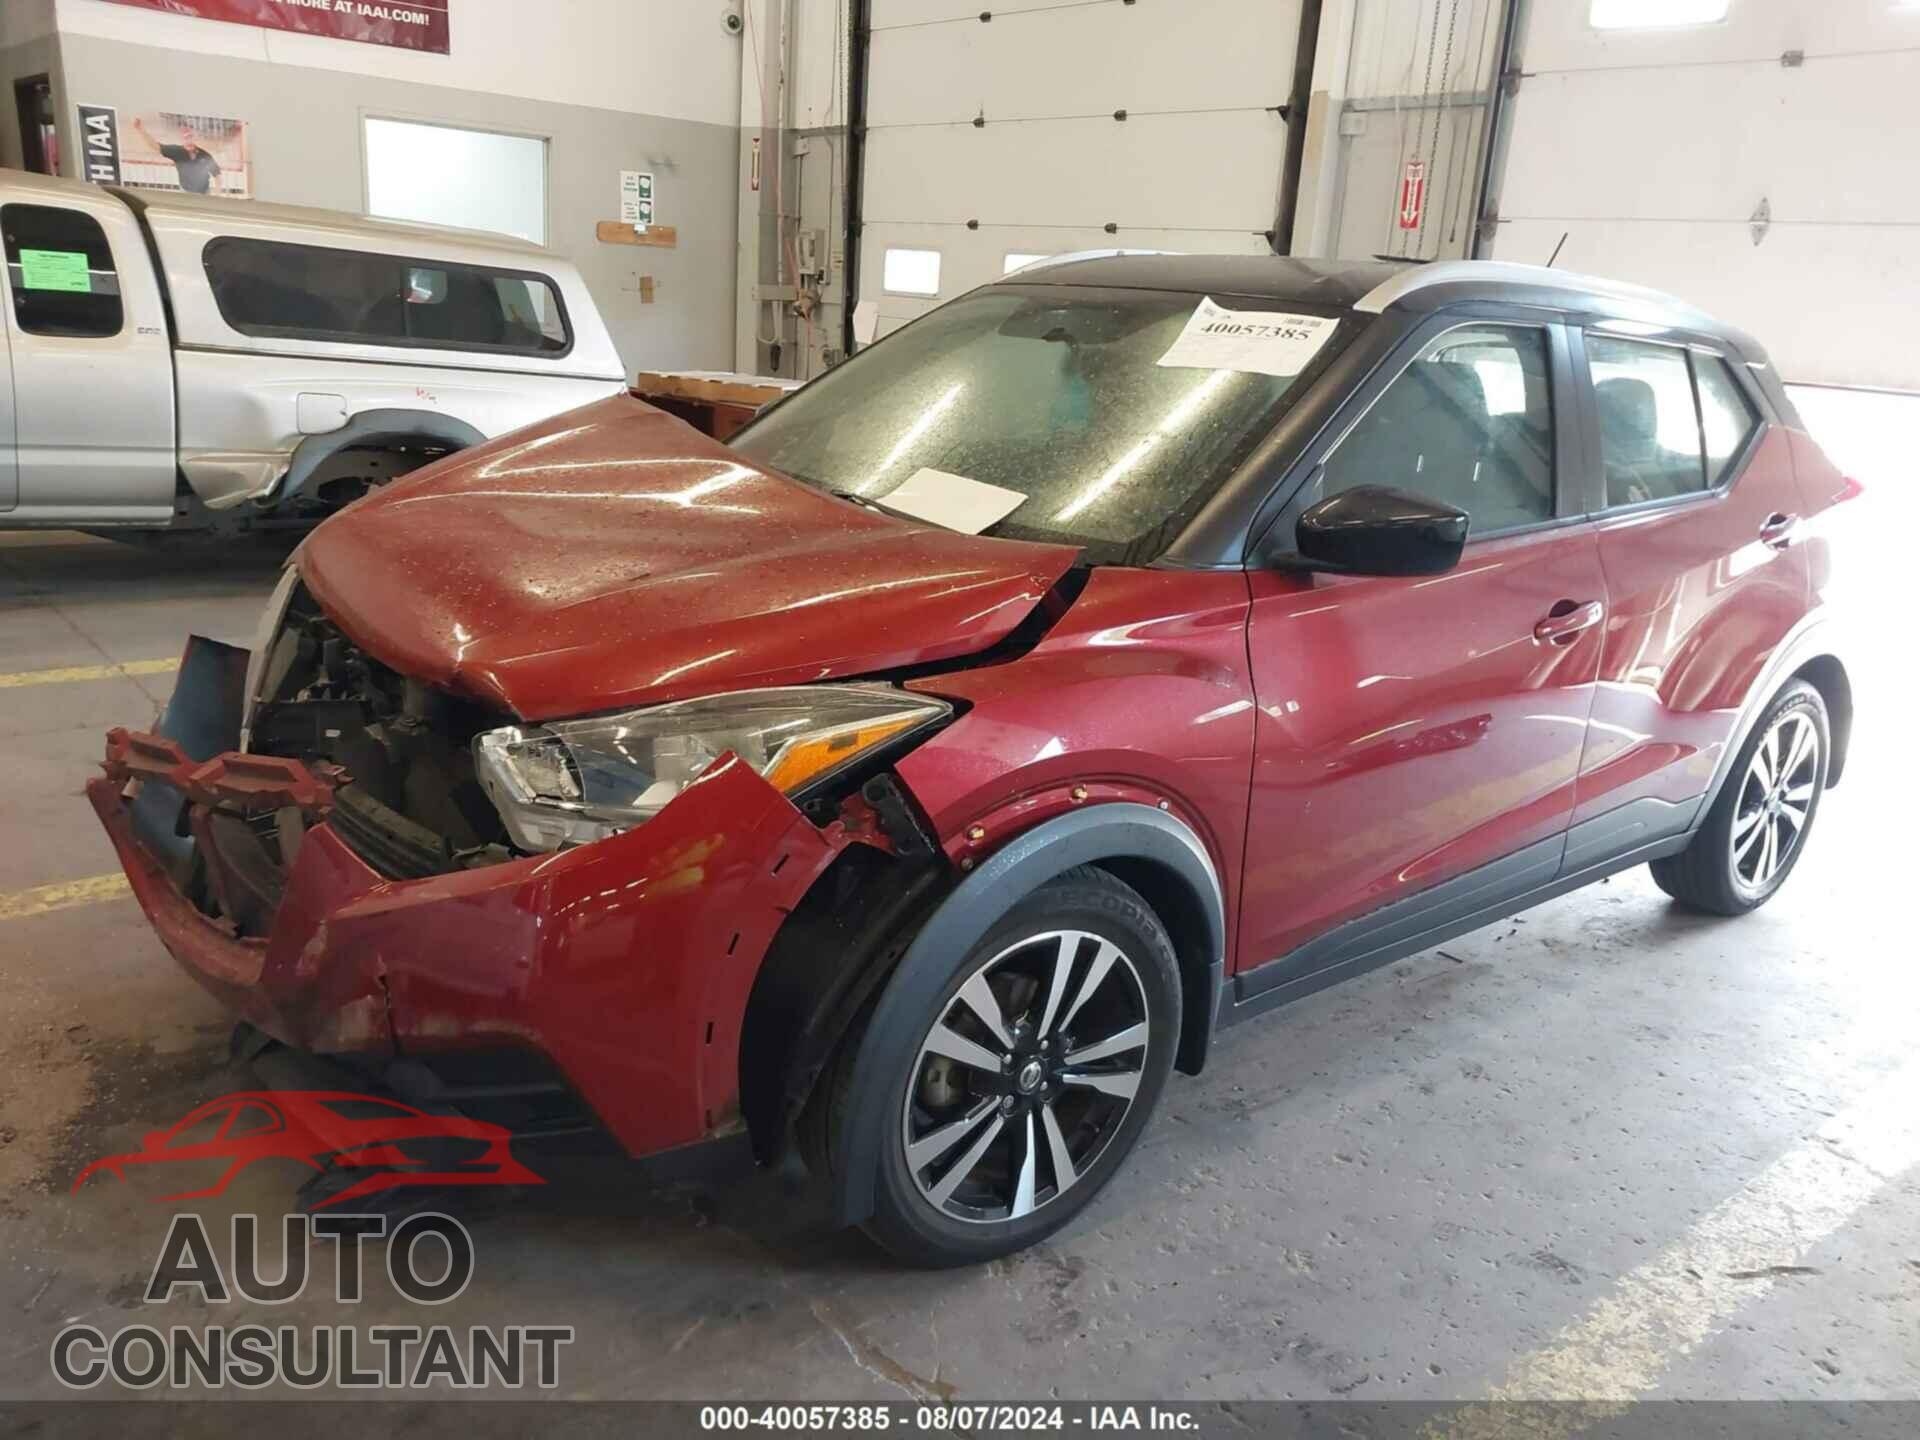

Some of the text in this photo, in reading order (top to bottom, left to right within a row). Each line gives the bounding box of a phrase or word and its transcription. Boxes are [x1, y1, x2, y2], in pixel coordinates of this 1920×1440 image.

[333, 0, 353, 13] AT
[357, 3, 430, 26] IAAI.COM!
[86, 114, 113, 157] IAA
[1200, 322, 1312, 341] 40057385
